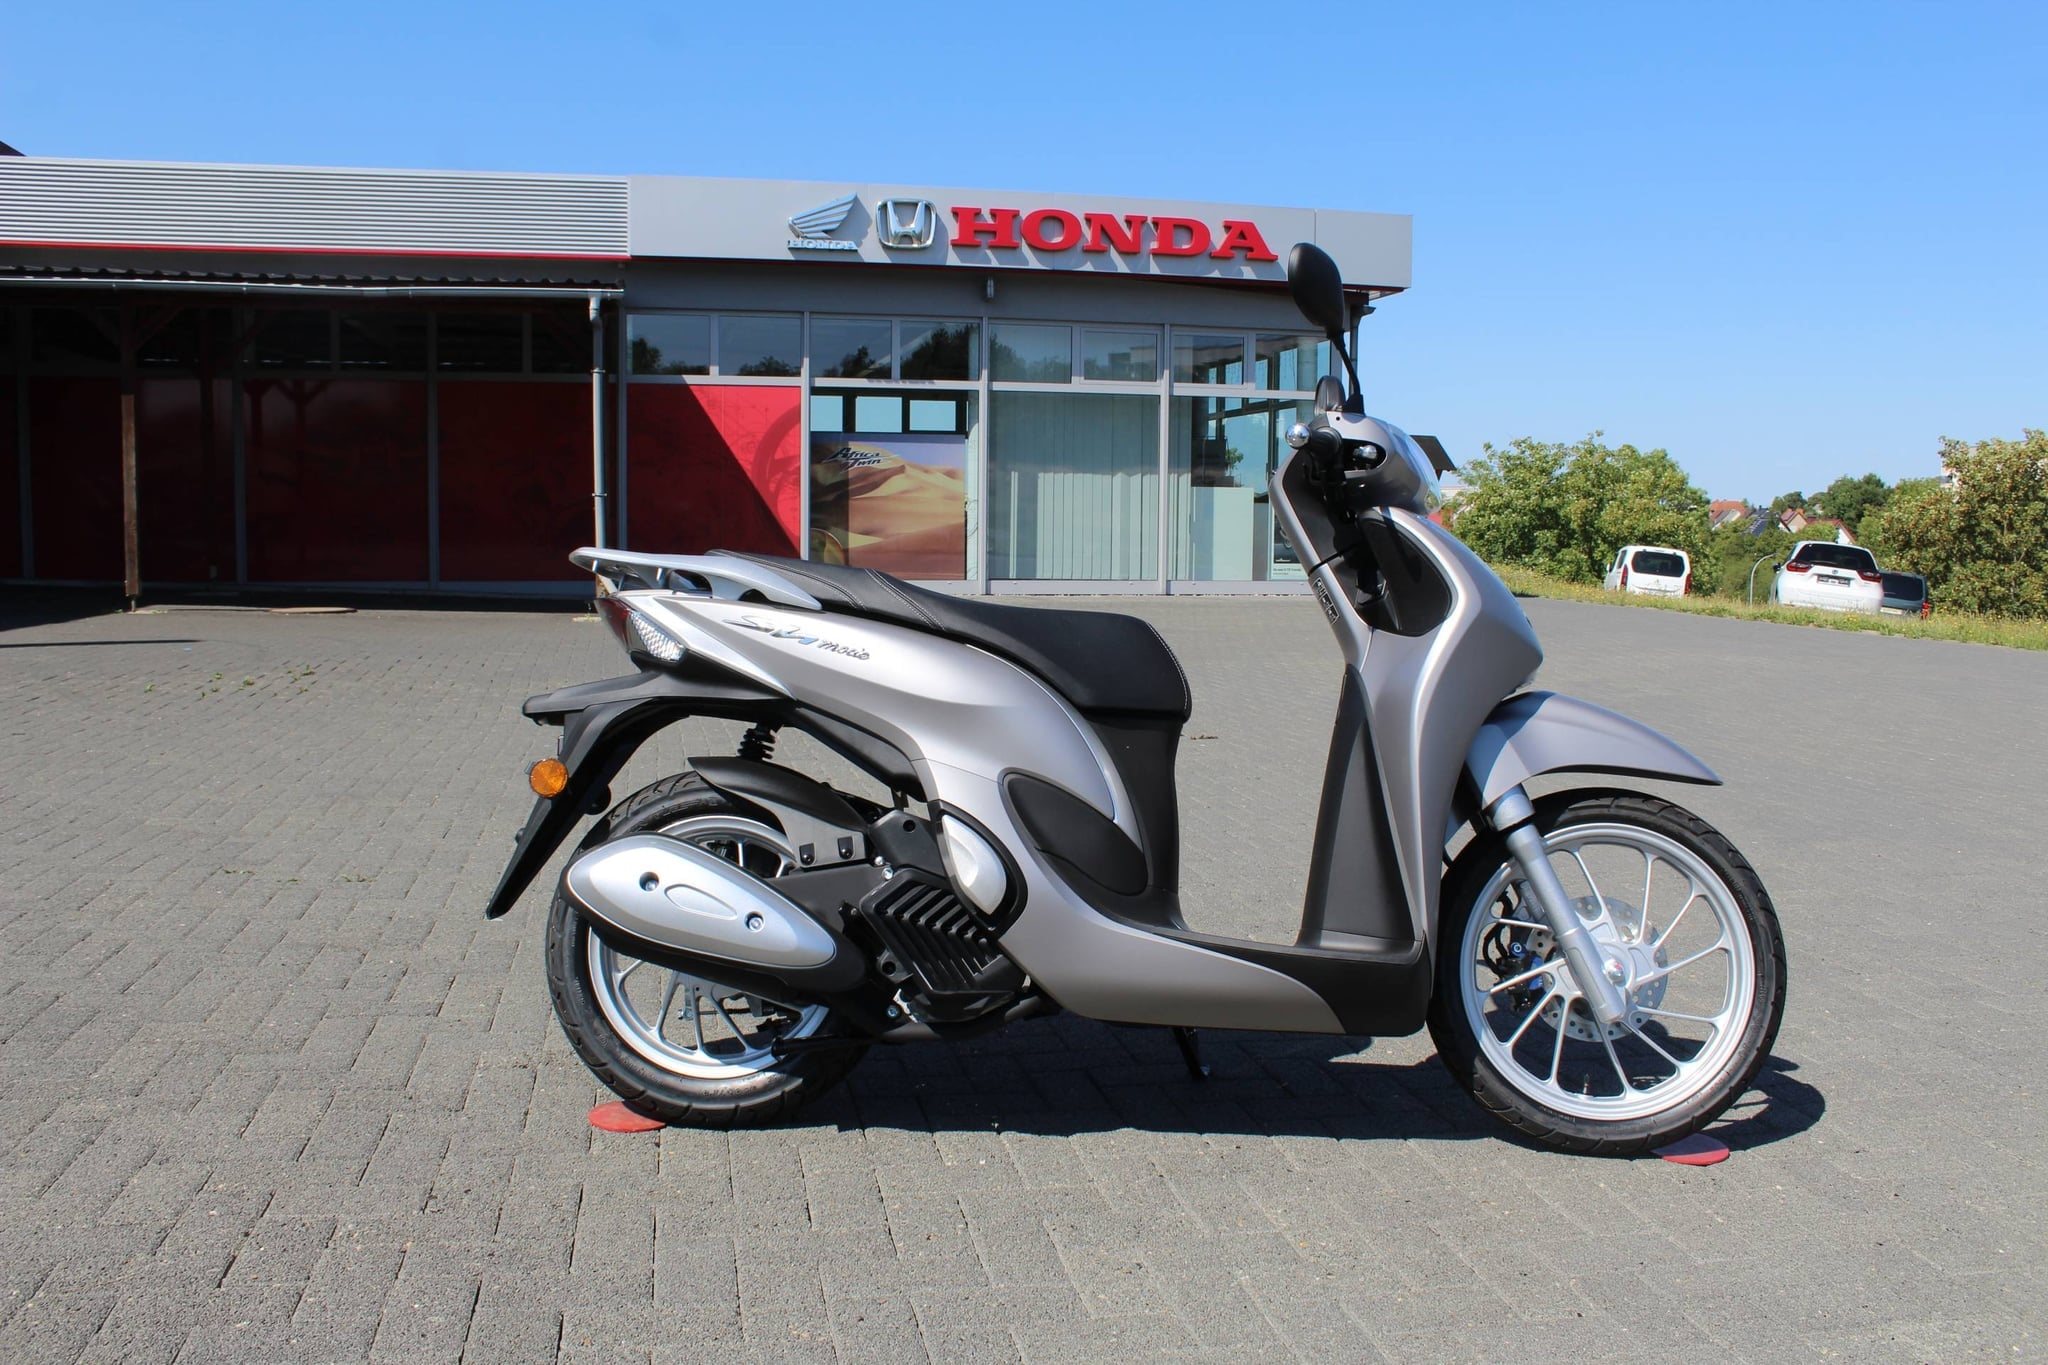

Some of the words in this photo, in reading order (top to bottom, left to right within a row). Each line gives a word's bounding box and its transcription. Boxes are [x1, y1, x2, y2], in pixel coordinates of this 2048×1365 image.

[950, 206, 1279, 262] HONDA
[788, 239, 858, 250] HONDA
[829, 446, 880, 459] Africa
[843, 457, 881, 470] Twin
